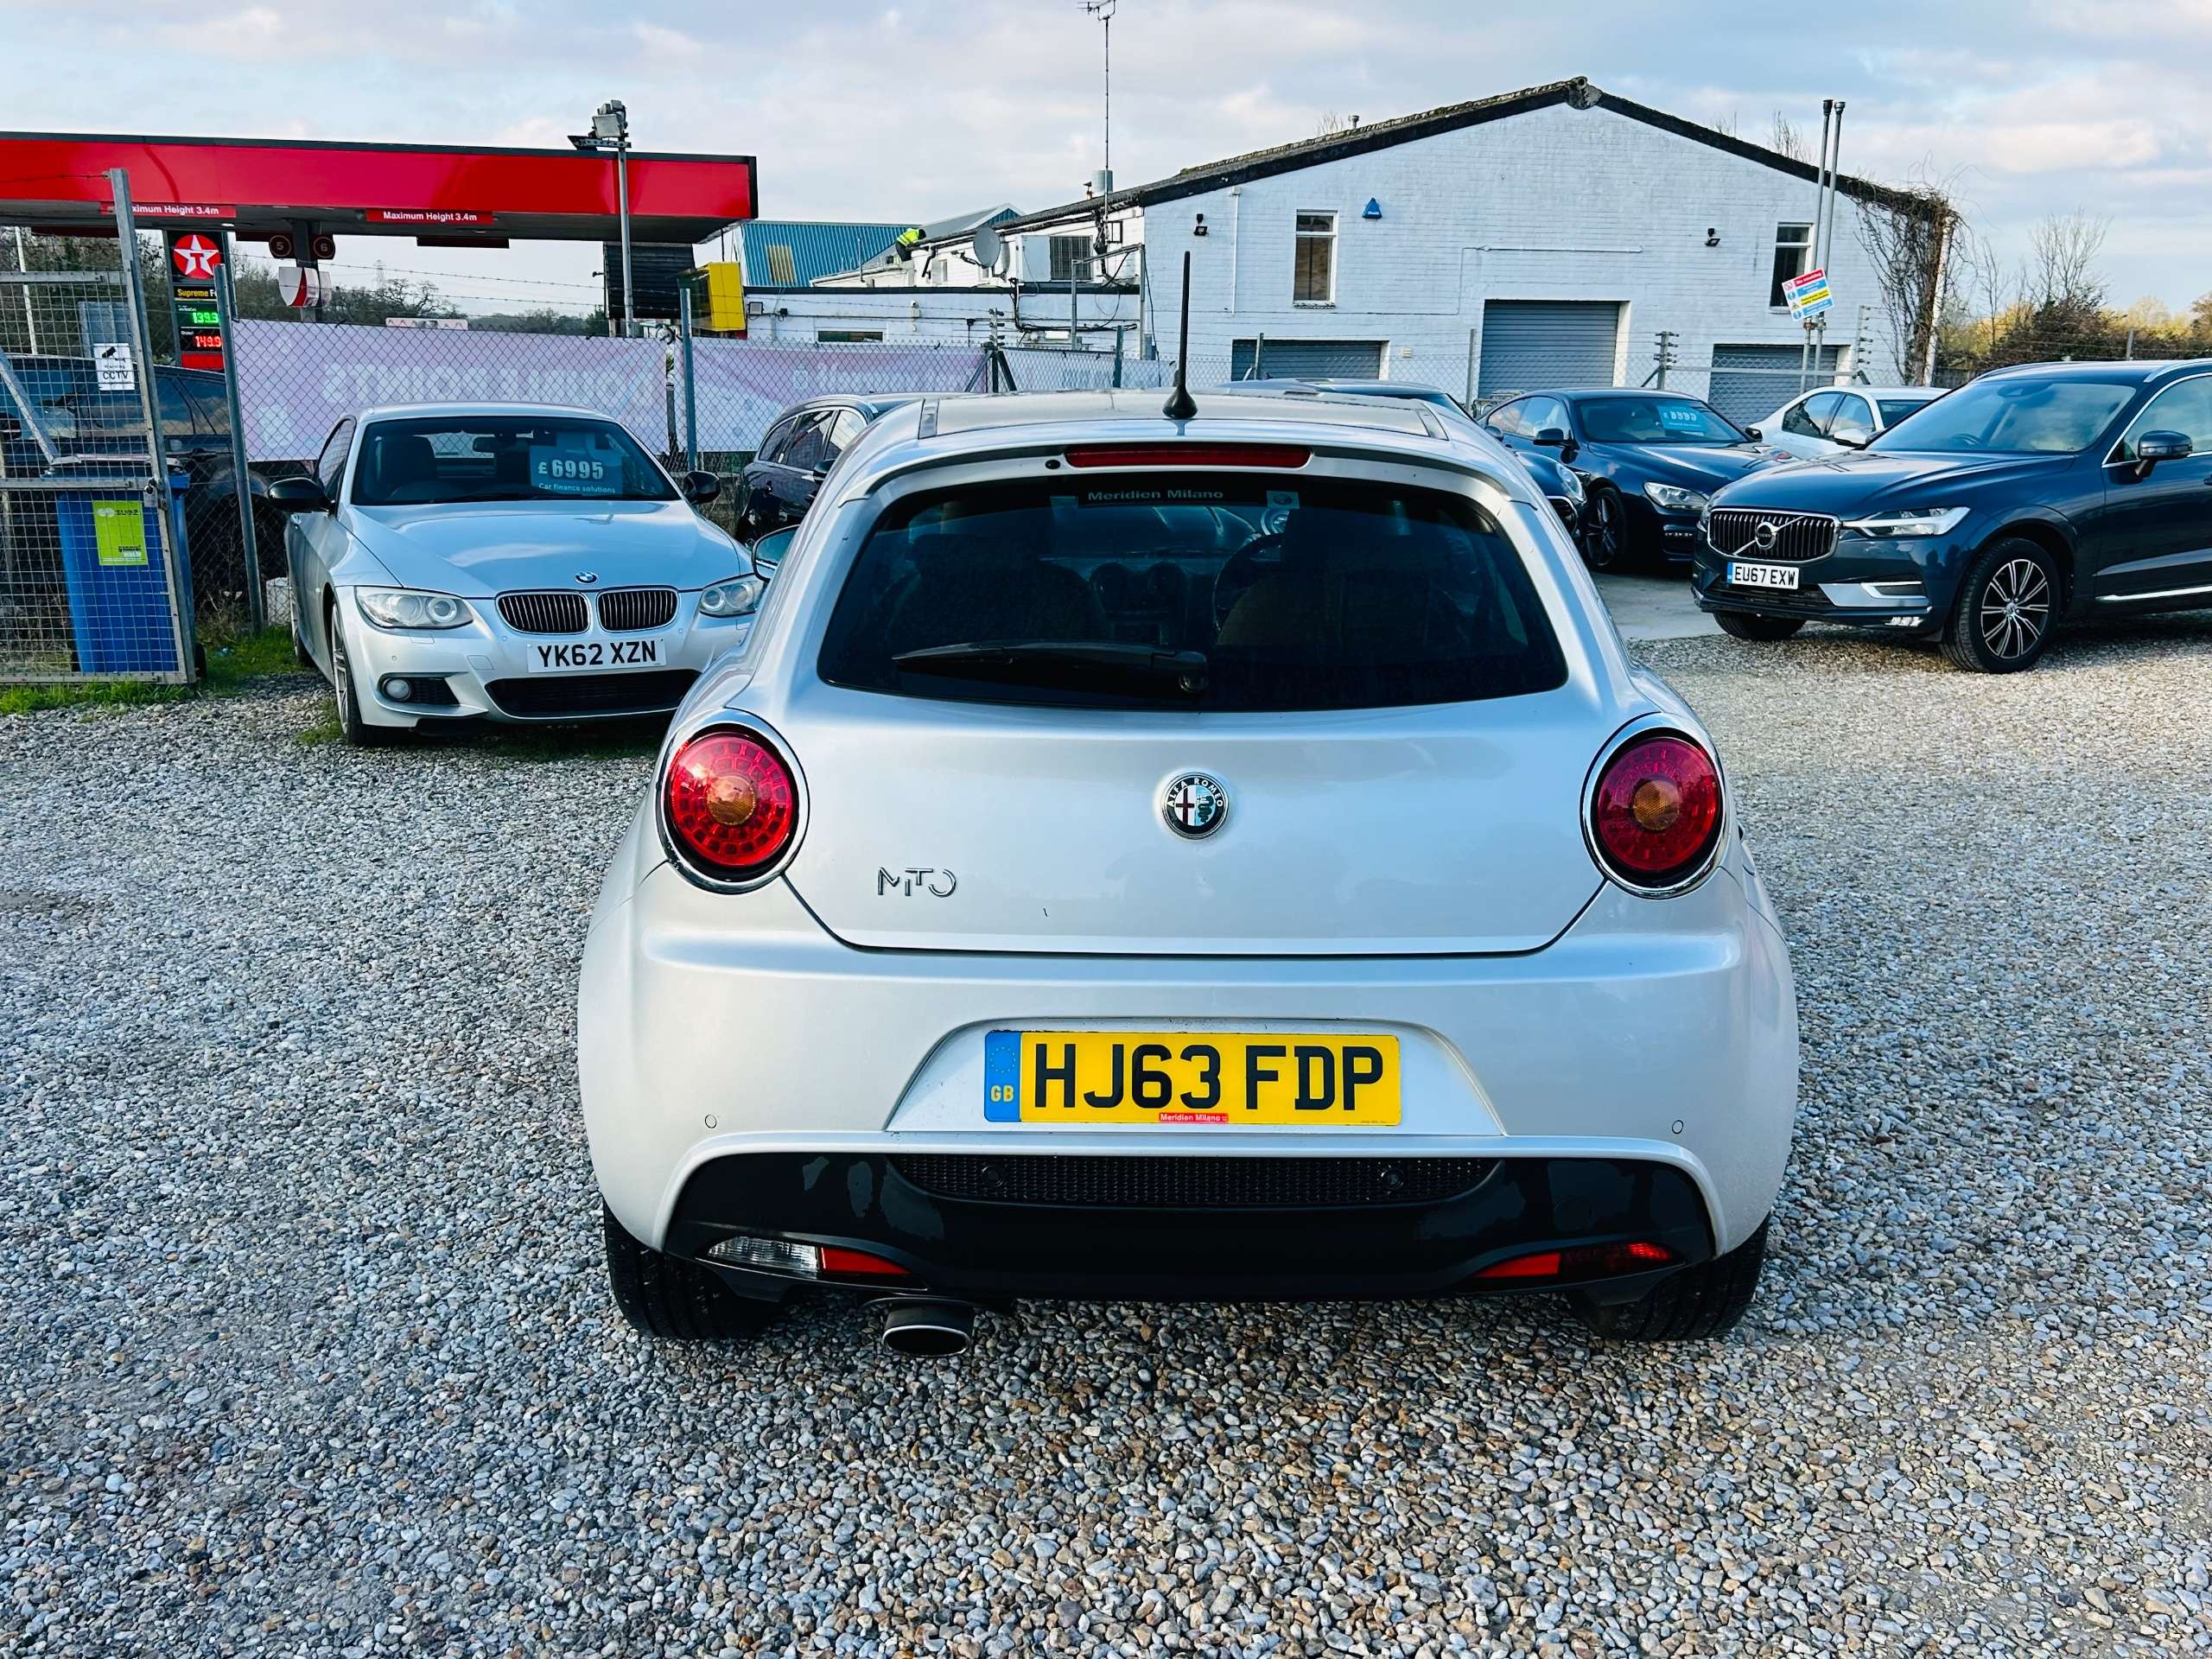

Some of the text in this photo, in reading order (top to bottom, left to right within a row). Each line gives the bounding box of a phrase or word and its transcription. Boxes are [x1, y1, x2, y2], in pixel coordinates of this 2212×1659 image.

[164, 205, 194, 216] Height
[196, 207, 219, 215] 3.4m
[383, 211, 478, 222] Maximum Height 3.4m
[276, 241, 284, 251] 5
[320, 243, 328, 252] 6
[176, 288, 209, 298] Supreme
[102, 371, 129, 380] CCTV
[537, 459, 604, 480] £ 6995
[553, 483, 581, 492] finance
[582, 486, 616, 494] solutions
[1087, 489, 1224, 501] Meridien Milano
[1734, 566, 1796, 587] EU67 EXW
[537, 640, 657, 668] YK62 XZN
[1166, 777, 1224, 808] ALFA ROMEO
[989, 1043, 1383, 1111] GB HJ63 FDP
[1159, 1113, 1194, 1122] Meridien
[1194, 1113, 1221, 1122] Milano
